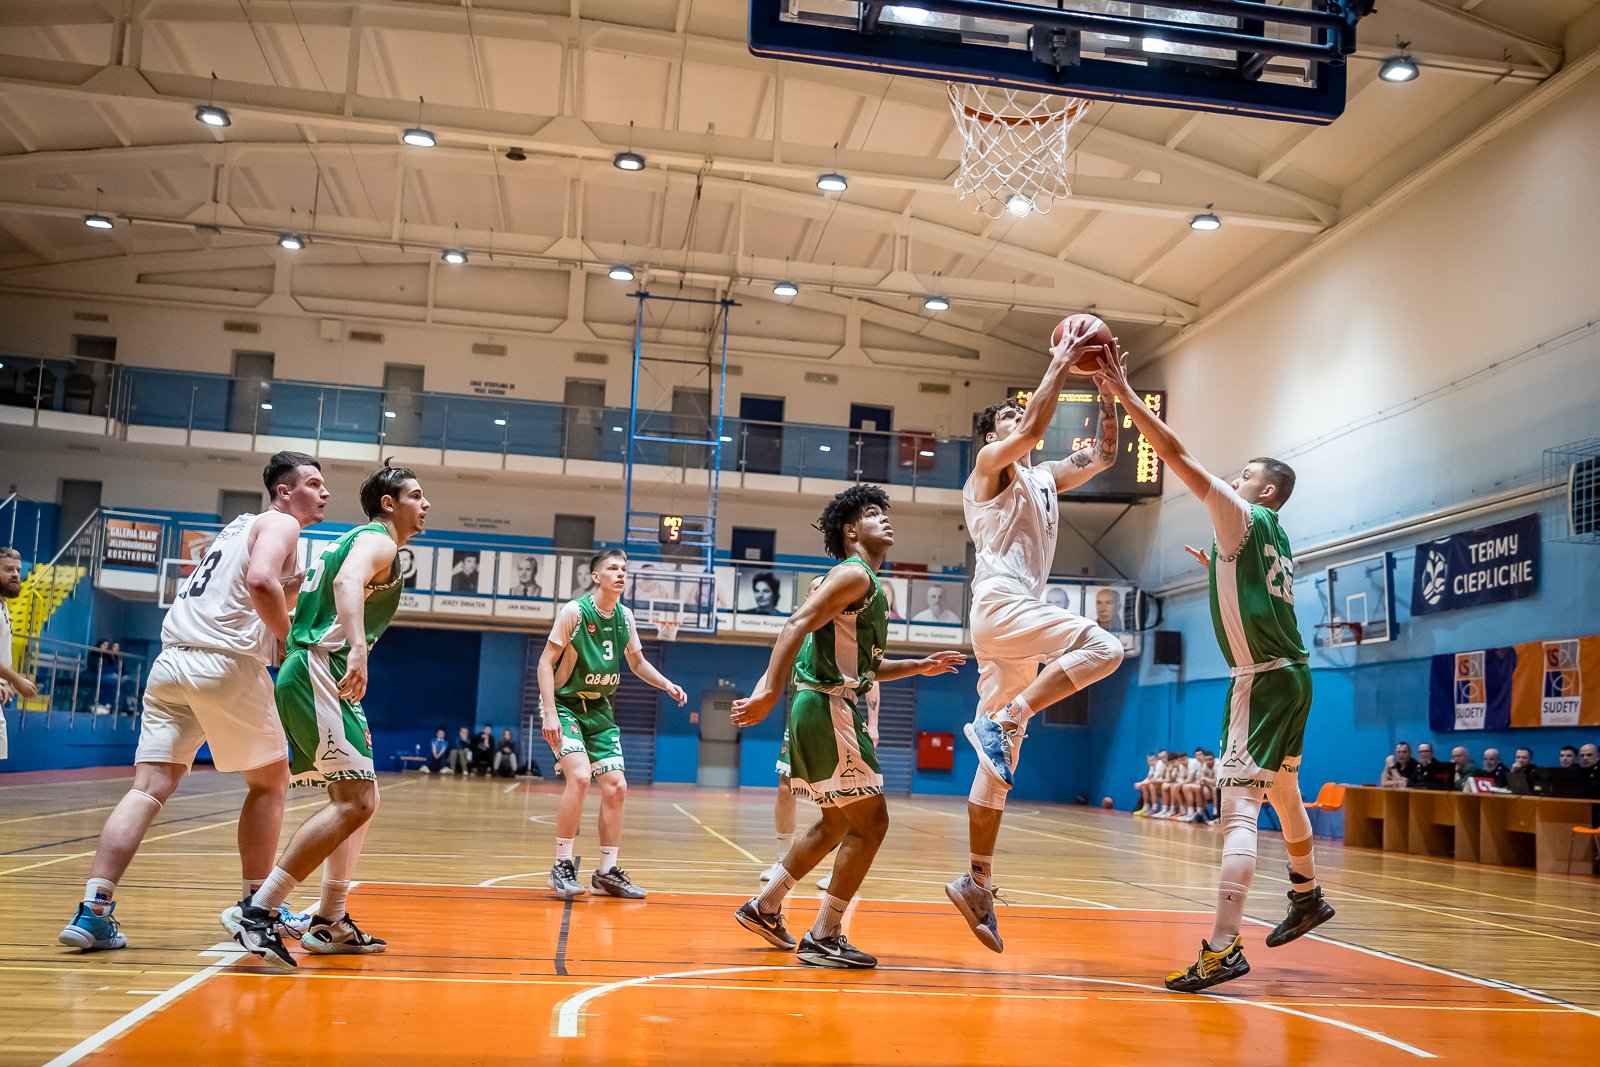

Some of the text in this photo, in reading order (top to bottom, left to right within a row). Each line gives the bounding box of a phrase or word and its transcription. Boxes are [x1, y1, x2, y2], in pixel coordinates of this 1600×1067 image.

[669, 526, 680, 541] 5
[1468, 533, 1519, 564] TERMY
[1453, 560, 1533, 595] CIEPLICKIE
[602, 640, 613, 661] 3
[1456, 706, 1485, 719] SUDETY
[1543, 700, 1579, 714] SUDETY
